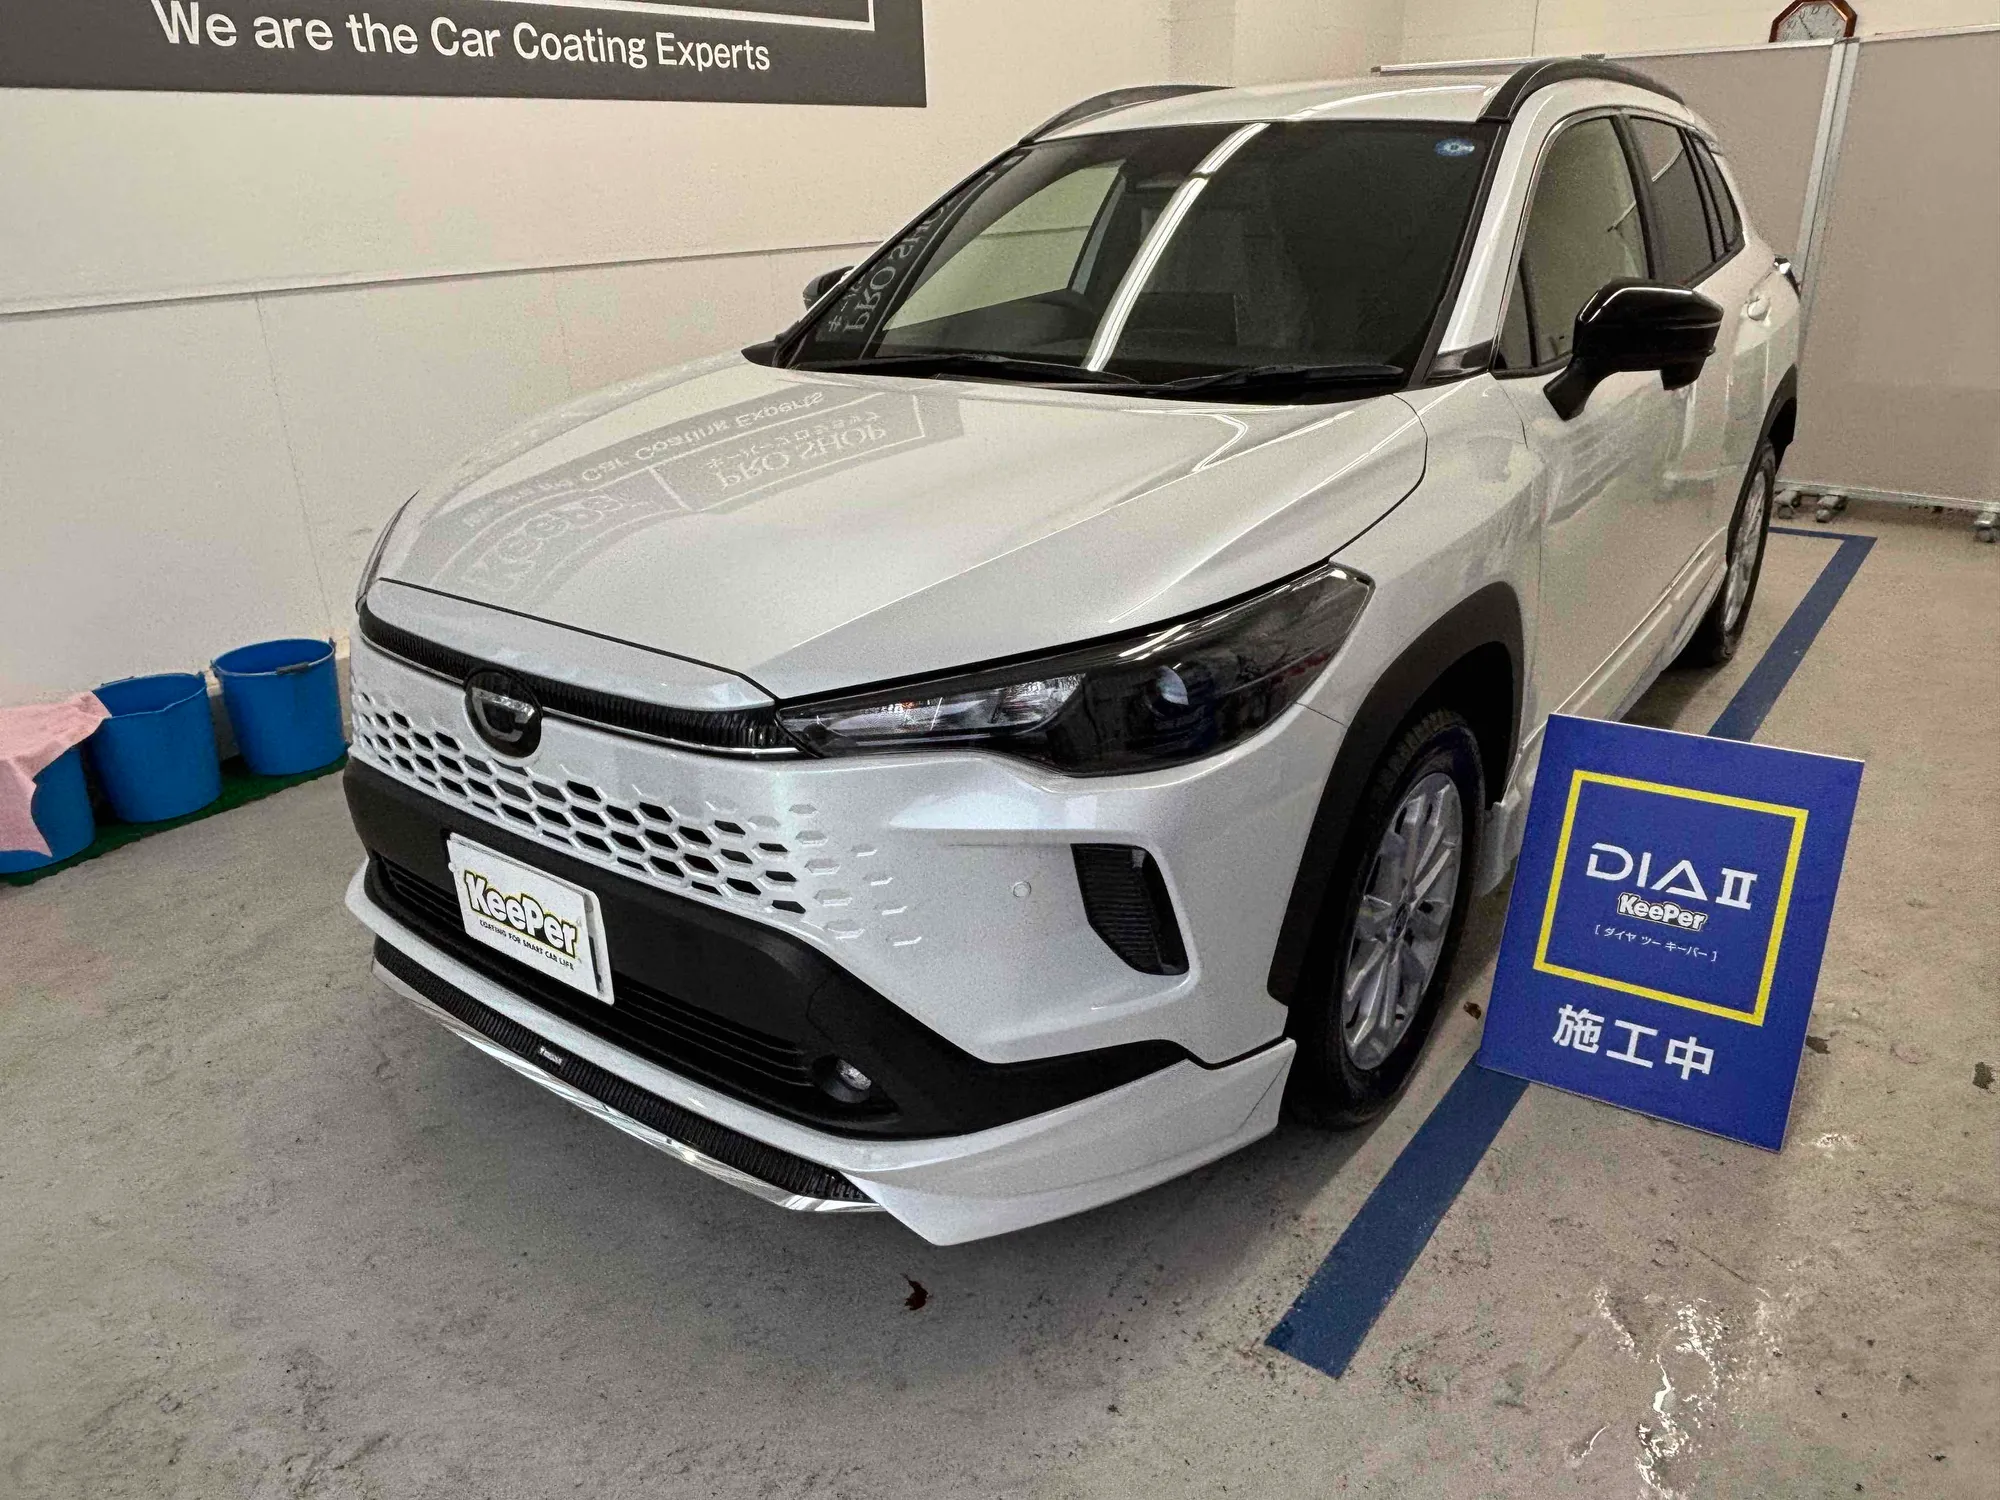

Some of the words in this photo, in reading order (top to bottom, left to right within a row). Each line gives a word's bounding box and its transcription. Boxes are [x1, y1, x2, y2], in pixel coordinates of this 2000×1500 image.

[151, 0, 238, 48] We
[252, 15, 334, 51] are
[345, 12, 419, 55] the
[430, 16, 501, 58] Car
[512, 22, 648, 69] Coating
[655, 31, 771, 71] Experts
[463, 870, 578, 959] KeePer
[1617, 892, 1708, 932] KeePer
[1552, 1003, 1715, 1081] 施工中
